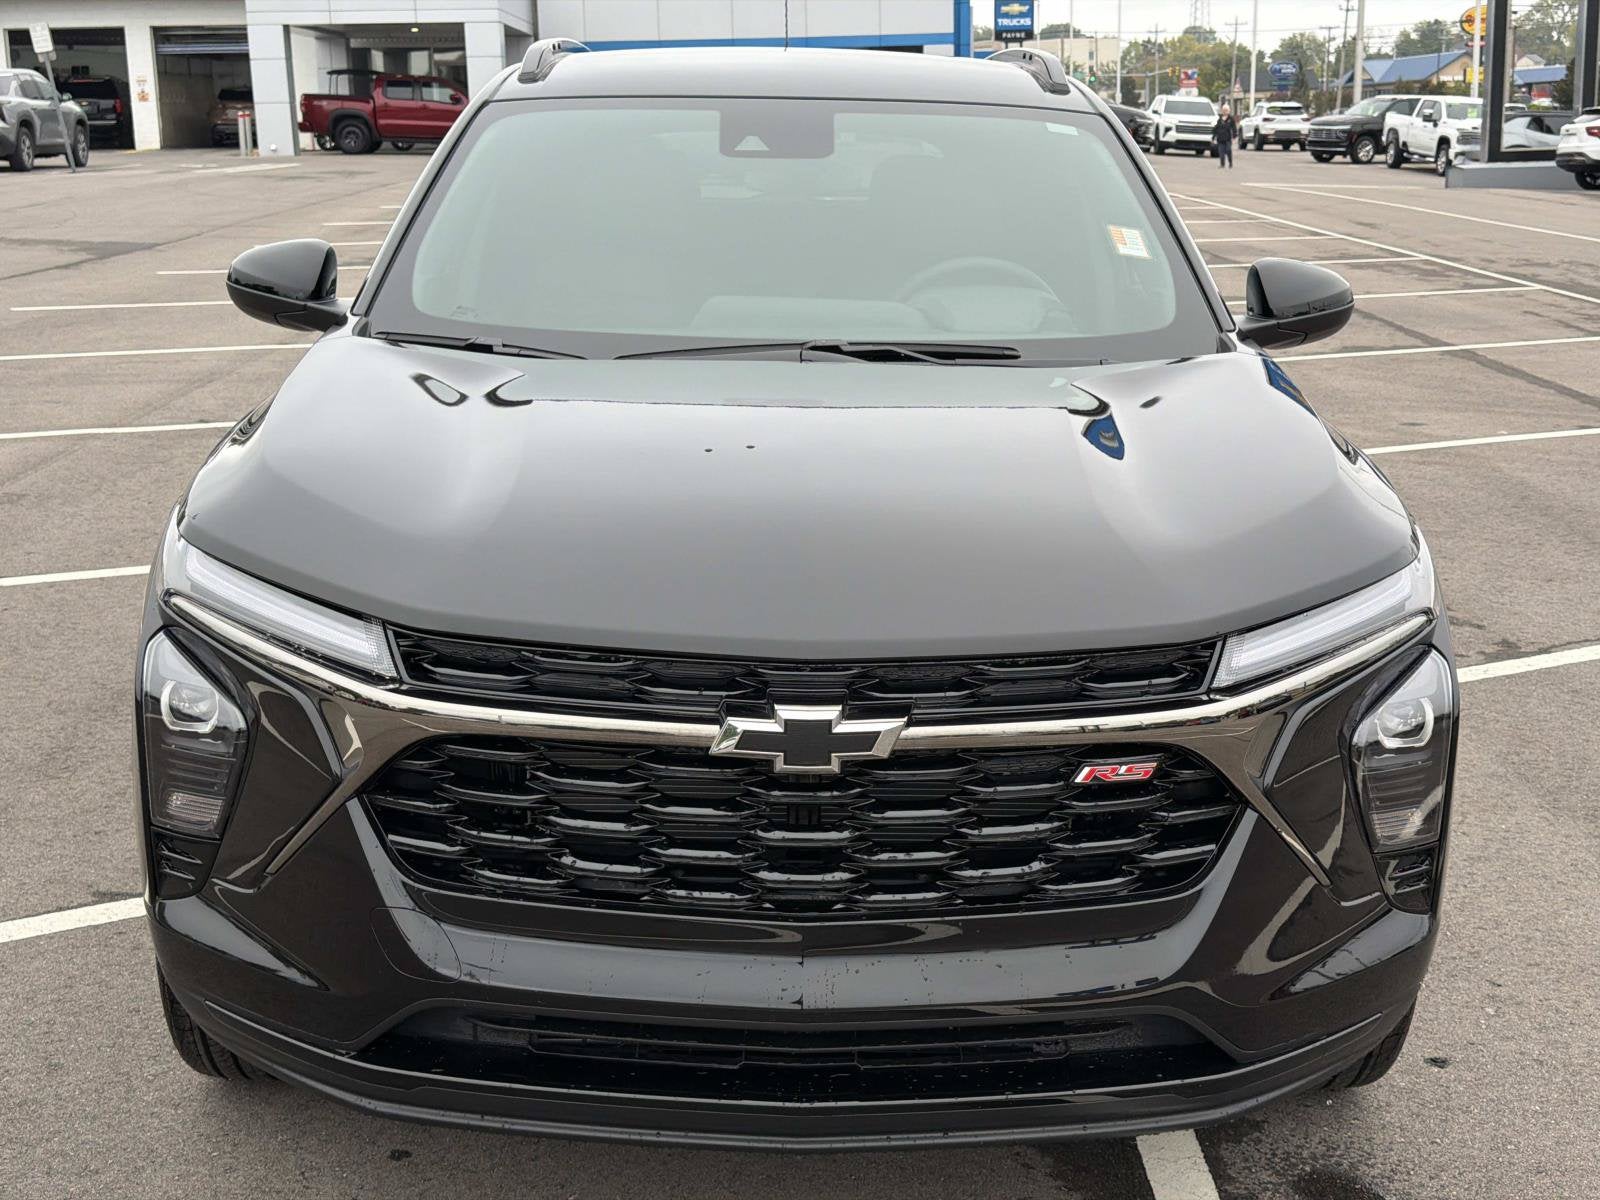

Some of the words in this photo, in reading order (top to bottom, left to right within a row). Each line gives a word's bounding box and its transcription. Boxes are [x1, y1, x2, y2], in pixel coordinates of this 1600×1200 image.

[997, 17, 1032, 26] TRUCKS
[1001, 31, 1026, 39] PAYNE
[1074, 763, 1157, 782] RS
